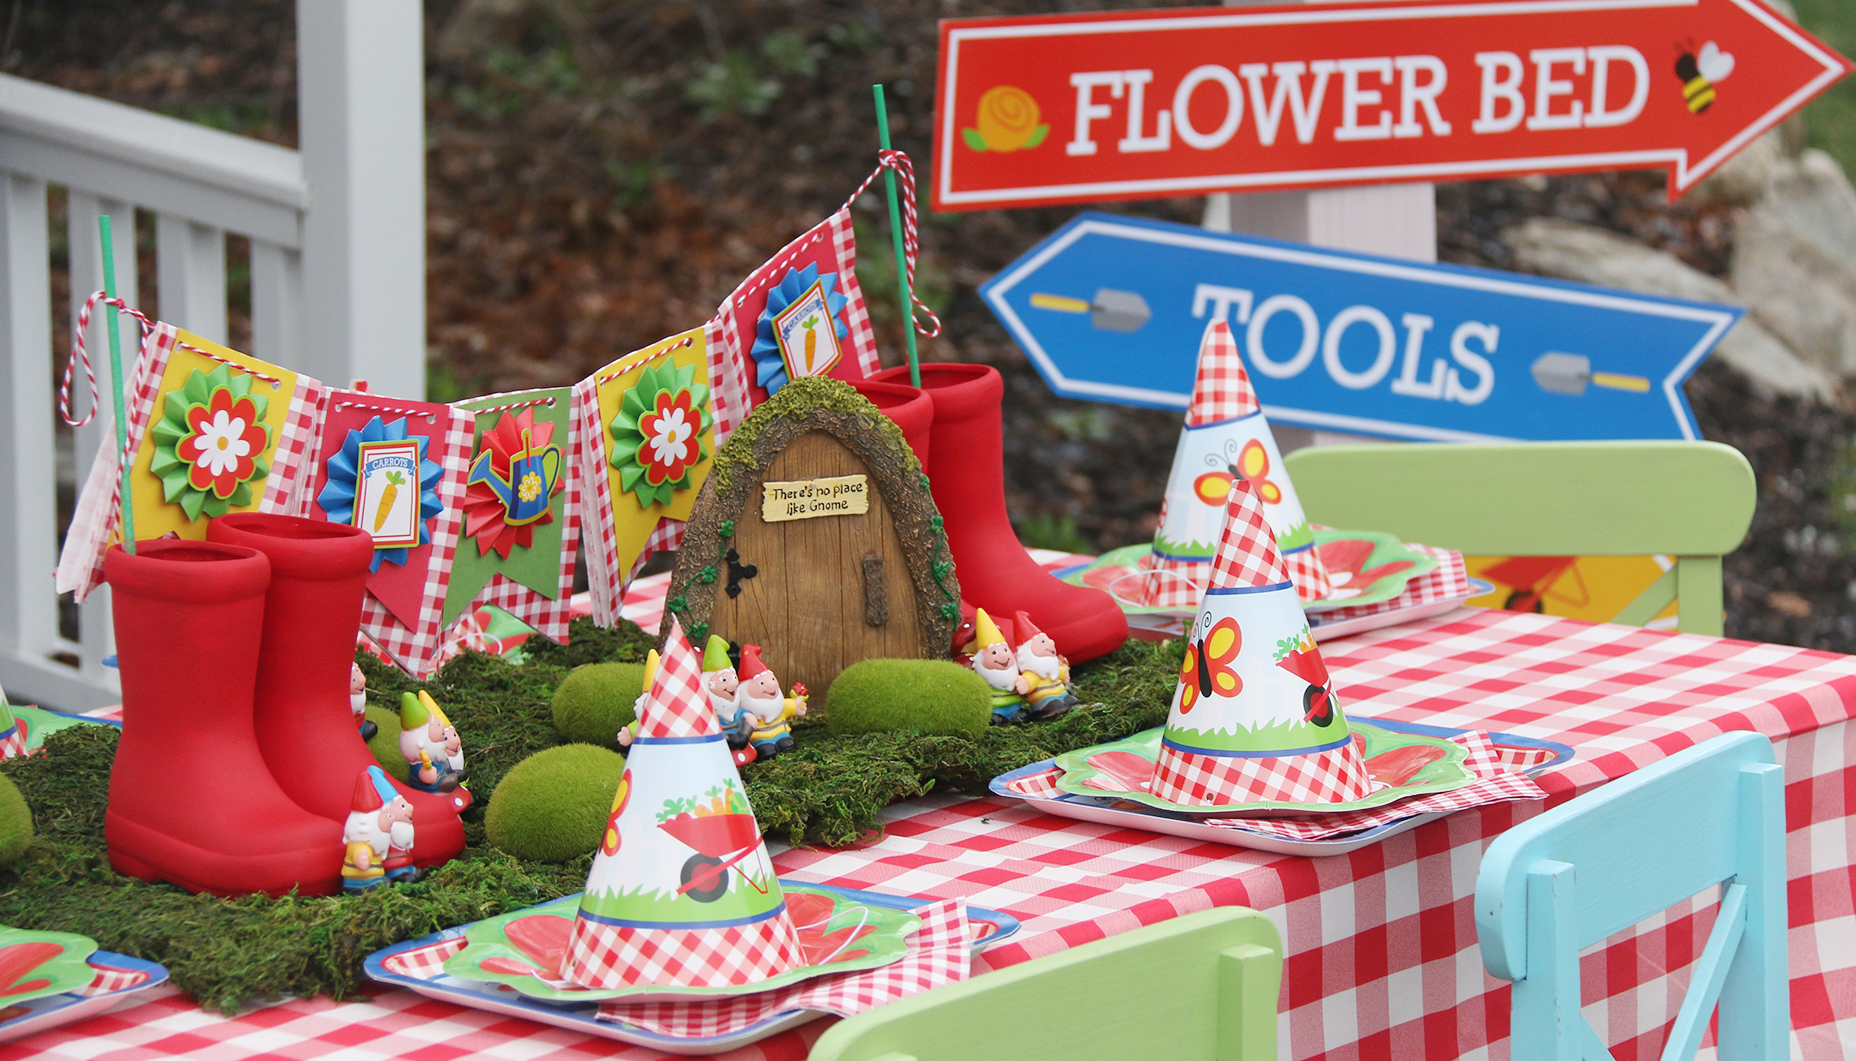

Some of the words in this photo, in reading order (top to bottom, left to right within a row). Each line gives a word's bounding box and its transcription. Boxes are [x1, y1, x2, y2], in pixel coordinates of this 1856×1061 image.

[1066, 54, 1452, 156] FLOWER
[1472, 44, 1651, 134] BED
[1192, 283, 1500, 405] TOOLS
[372, 457, 408, 469] CARROTS
[773, 485, 812, 500] There's
[816, 487, 831, 497] no
[833, 483, 863, 498] place
[786, 502, 806, 516] like
[809, 499, 849, 512] Gnome
